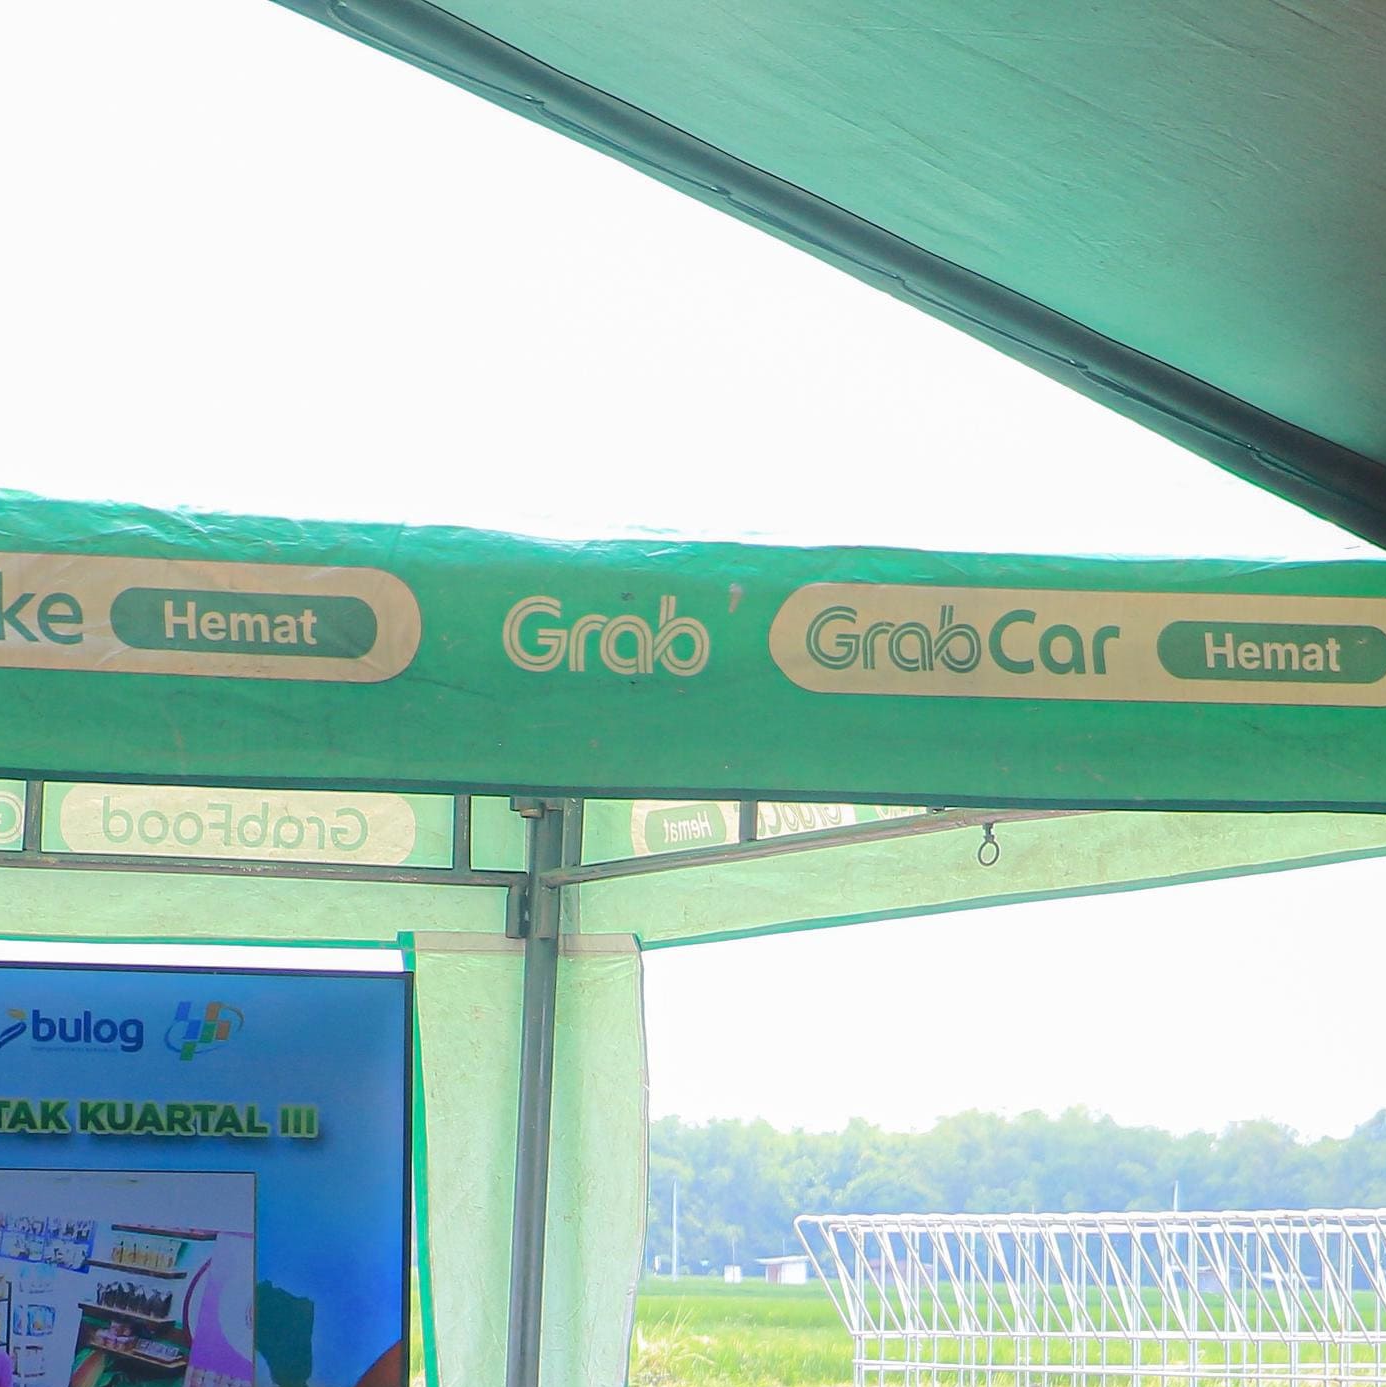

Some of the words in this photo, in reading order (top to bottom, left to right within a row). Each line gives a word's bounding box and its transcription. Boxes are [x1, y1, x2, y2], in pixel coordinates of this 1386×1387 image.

[164, 601, 317, 645] Hemat
[503, 595, 709, 677] Grab
[806, 605, 1120, 676] GrabCar
[1204, 633, 1340, 673] Hemat
[32, 1009, 145, 1053] bulog
[79, 1102, 268, 1137] KUARTAL
[279, 1107, 318, 1138] III
